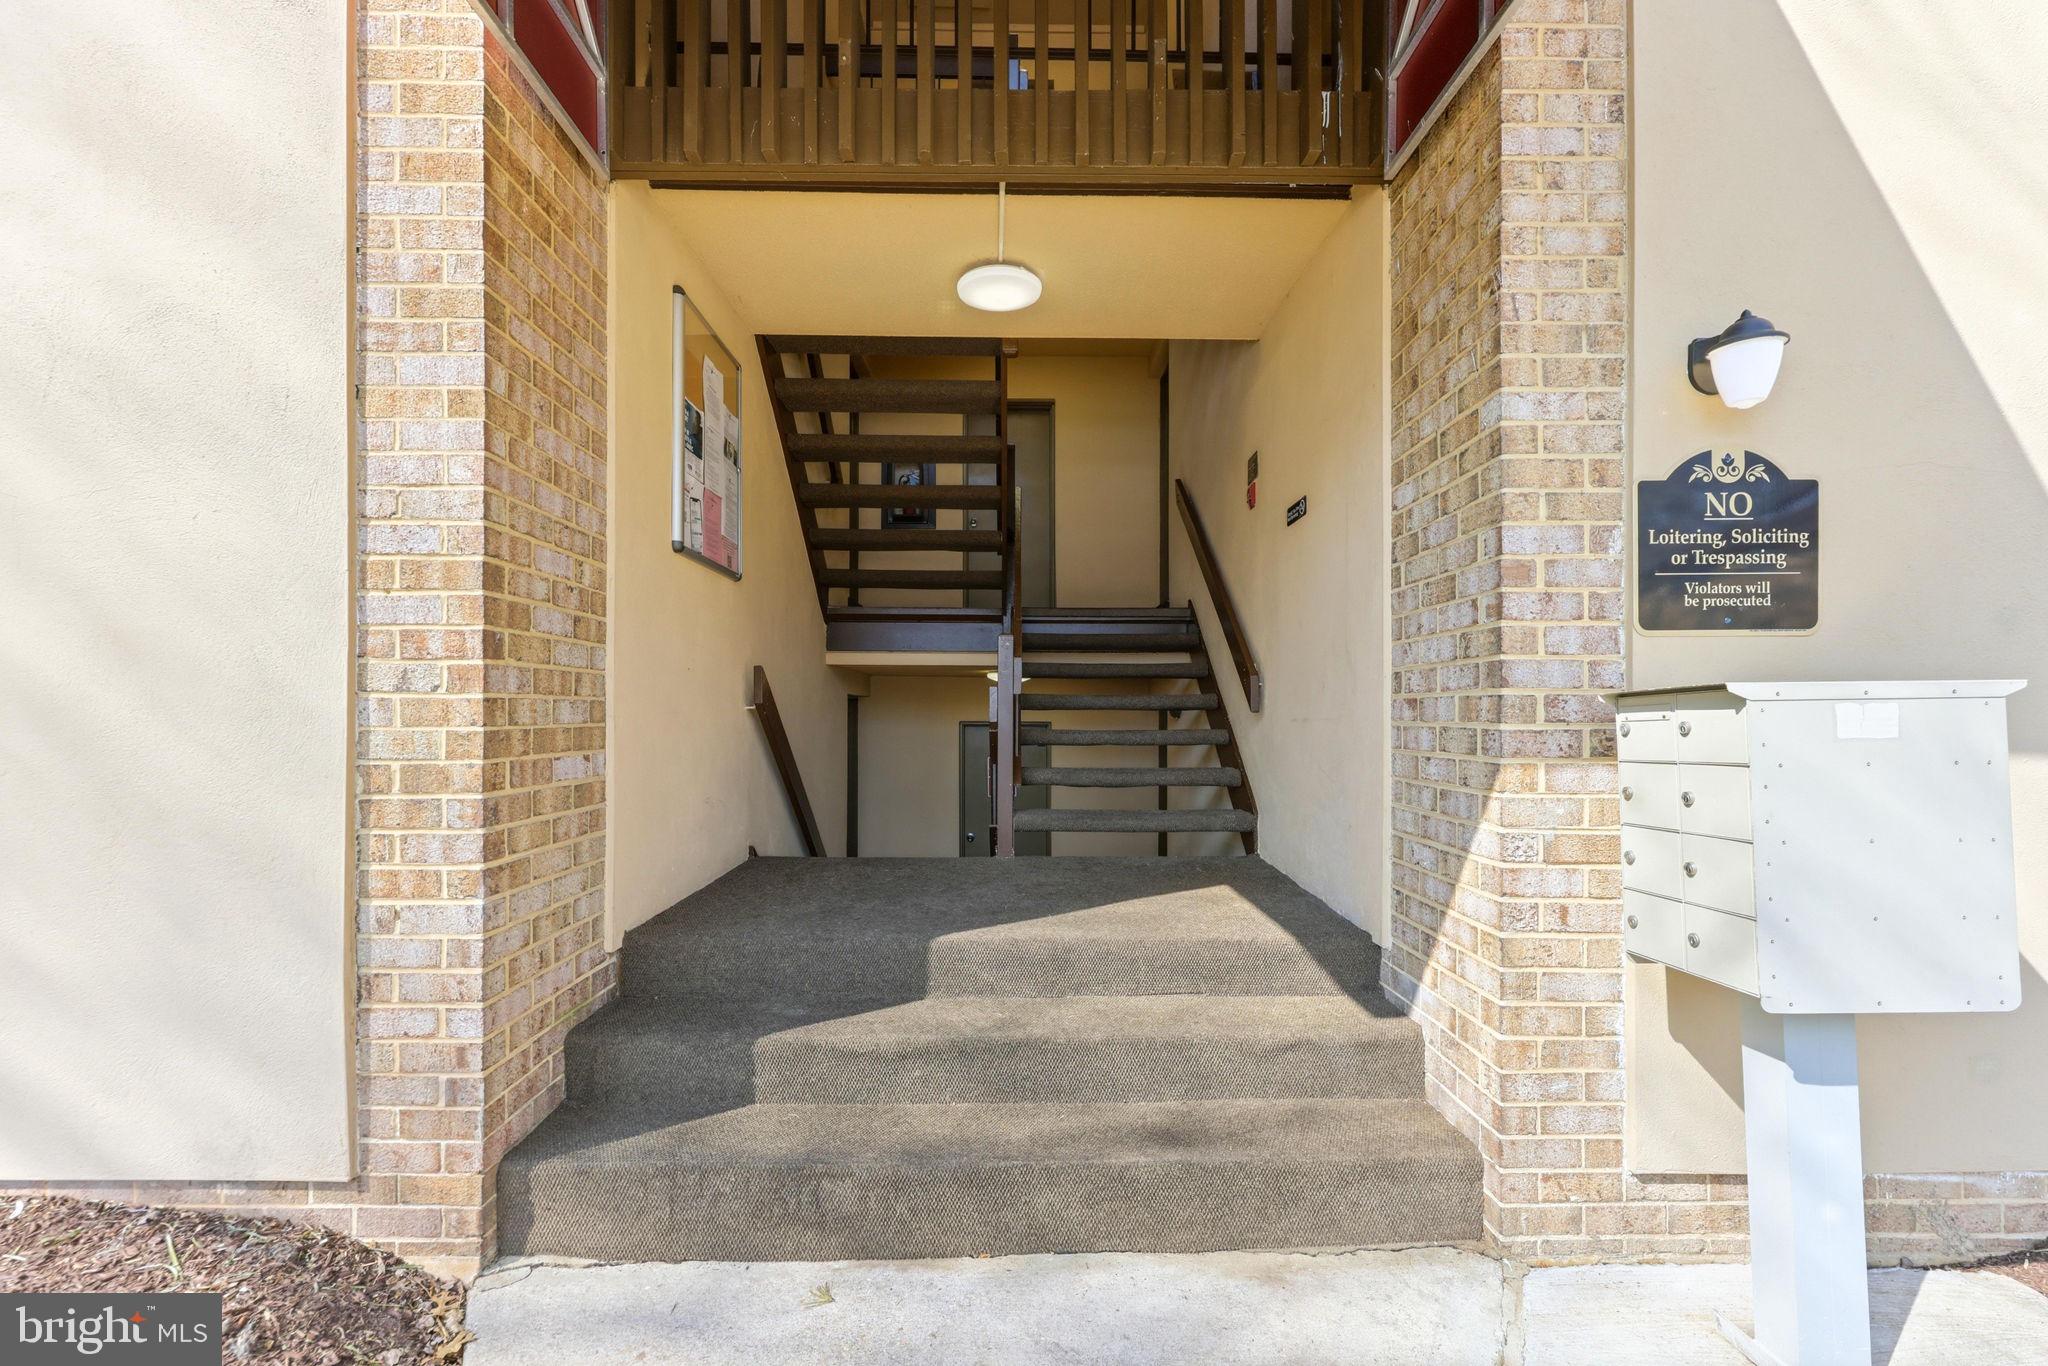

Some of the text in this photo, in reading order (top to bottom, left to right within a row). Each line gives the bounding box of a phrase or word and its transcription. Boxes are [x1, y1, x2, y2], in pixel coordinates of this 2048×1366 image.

[1704, 492, 1753, 516] NO
[1649, 528, 1810, 548] Loitering, Soliciting
[1671, 549, 1787, 569] or Trespassing
[1684, 581, 1771, 594] Violators will
[1684, 594, 1772, 610] be prosecuted
